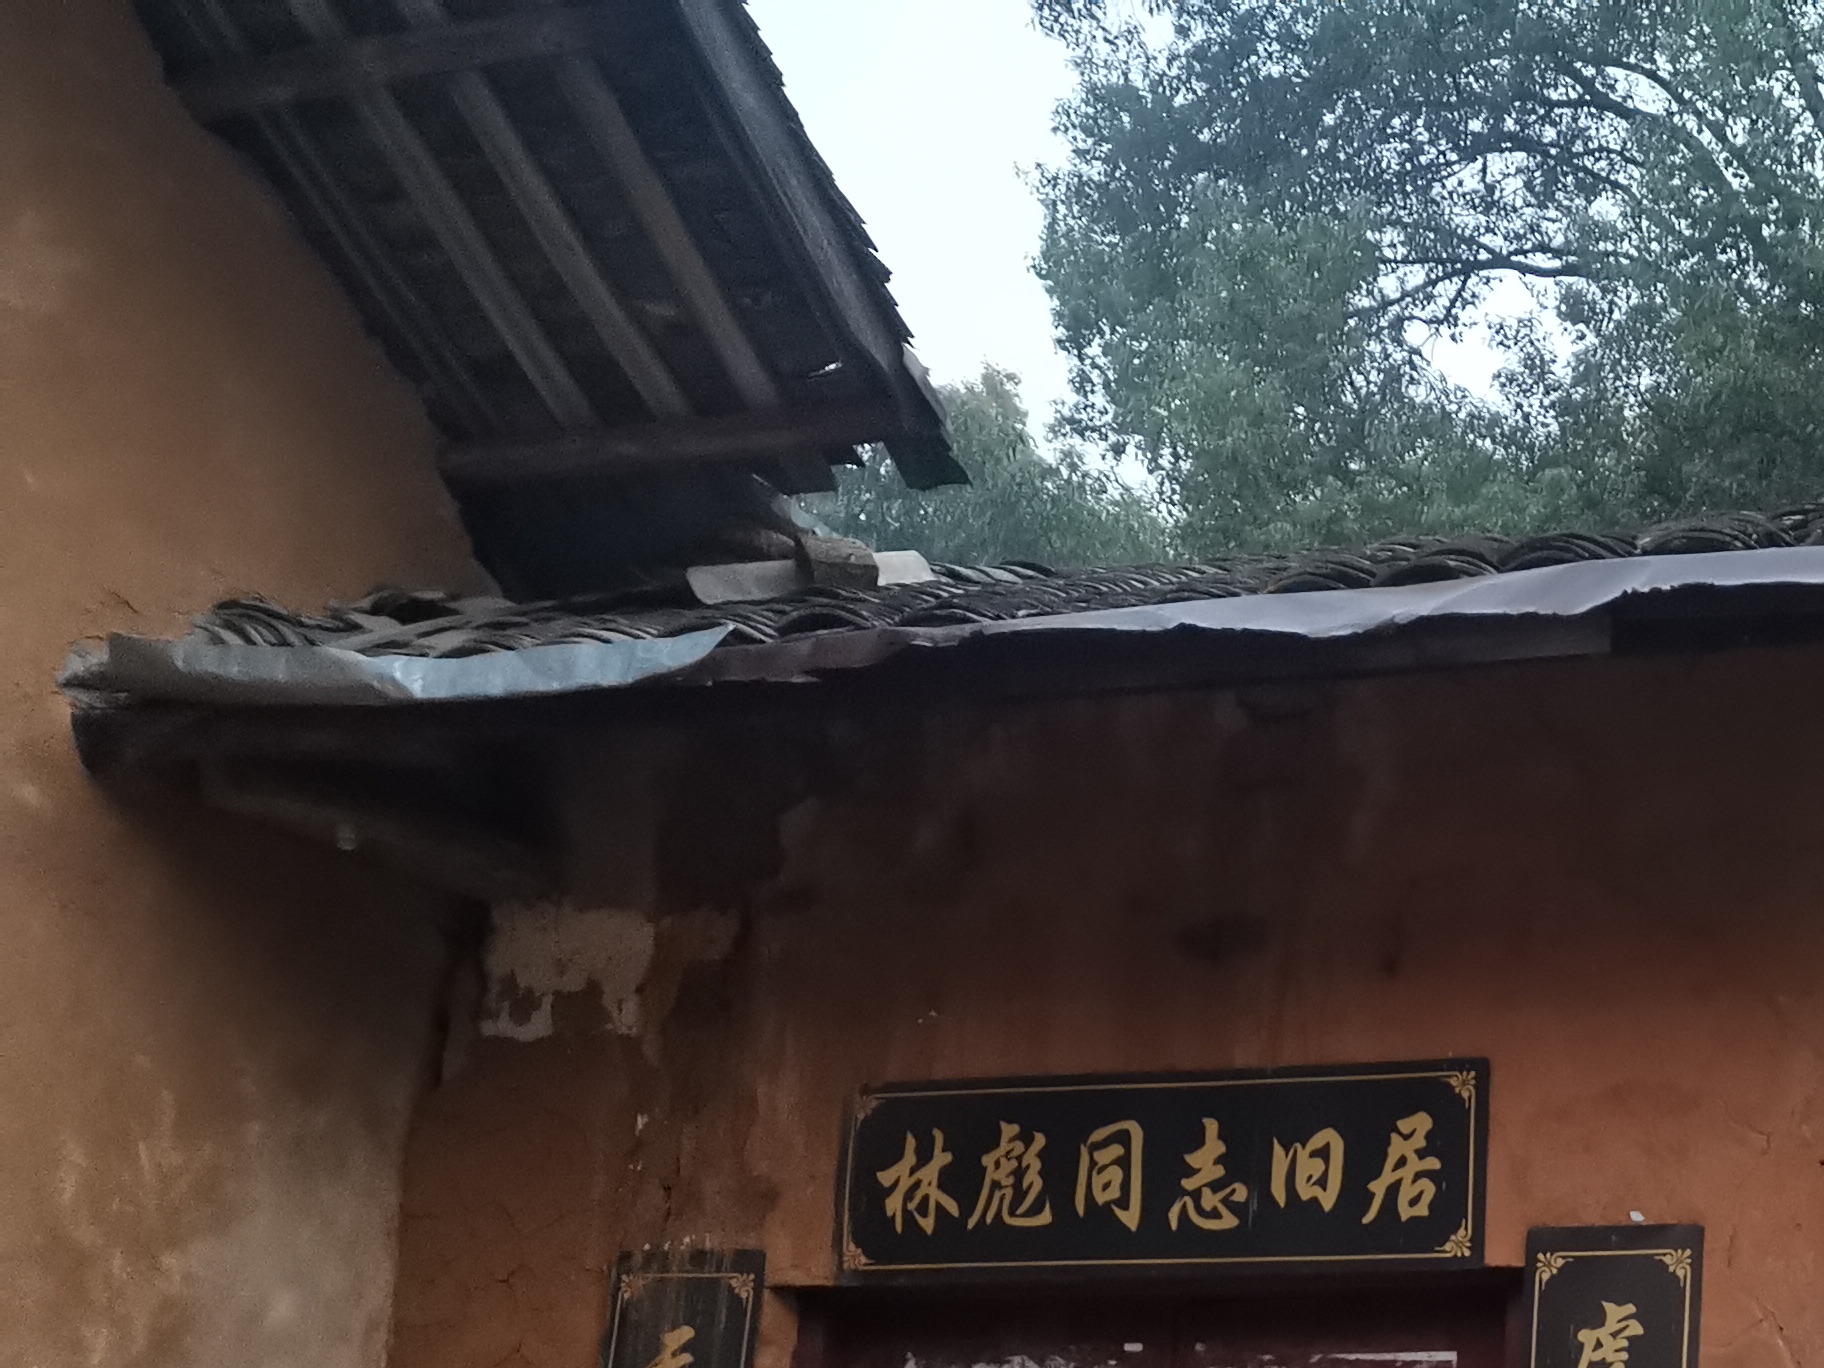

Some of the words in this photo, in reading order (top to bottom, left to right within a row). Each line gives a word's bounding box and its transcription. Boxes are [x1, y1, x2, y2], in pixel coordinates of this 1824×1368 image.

[876, 1111, 1442, 1236] 林彪同志旧居
